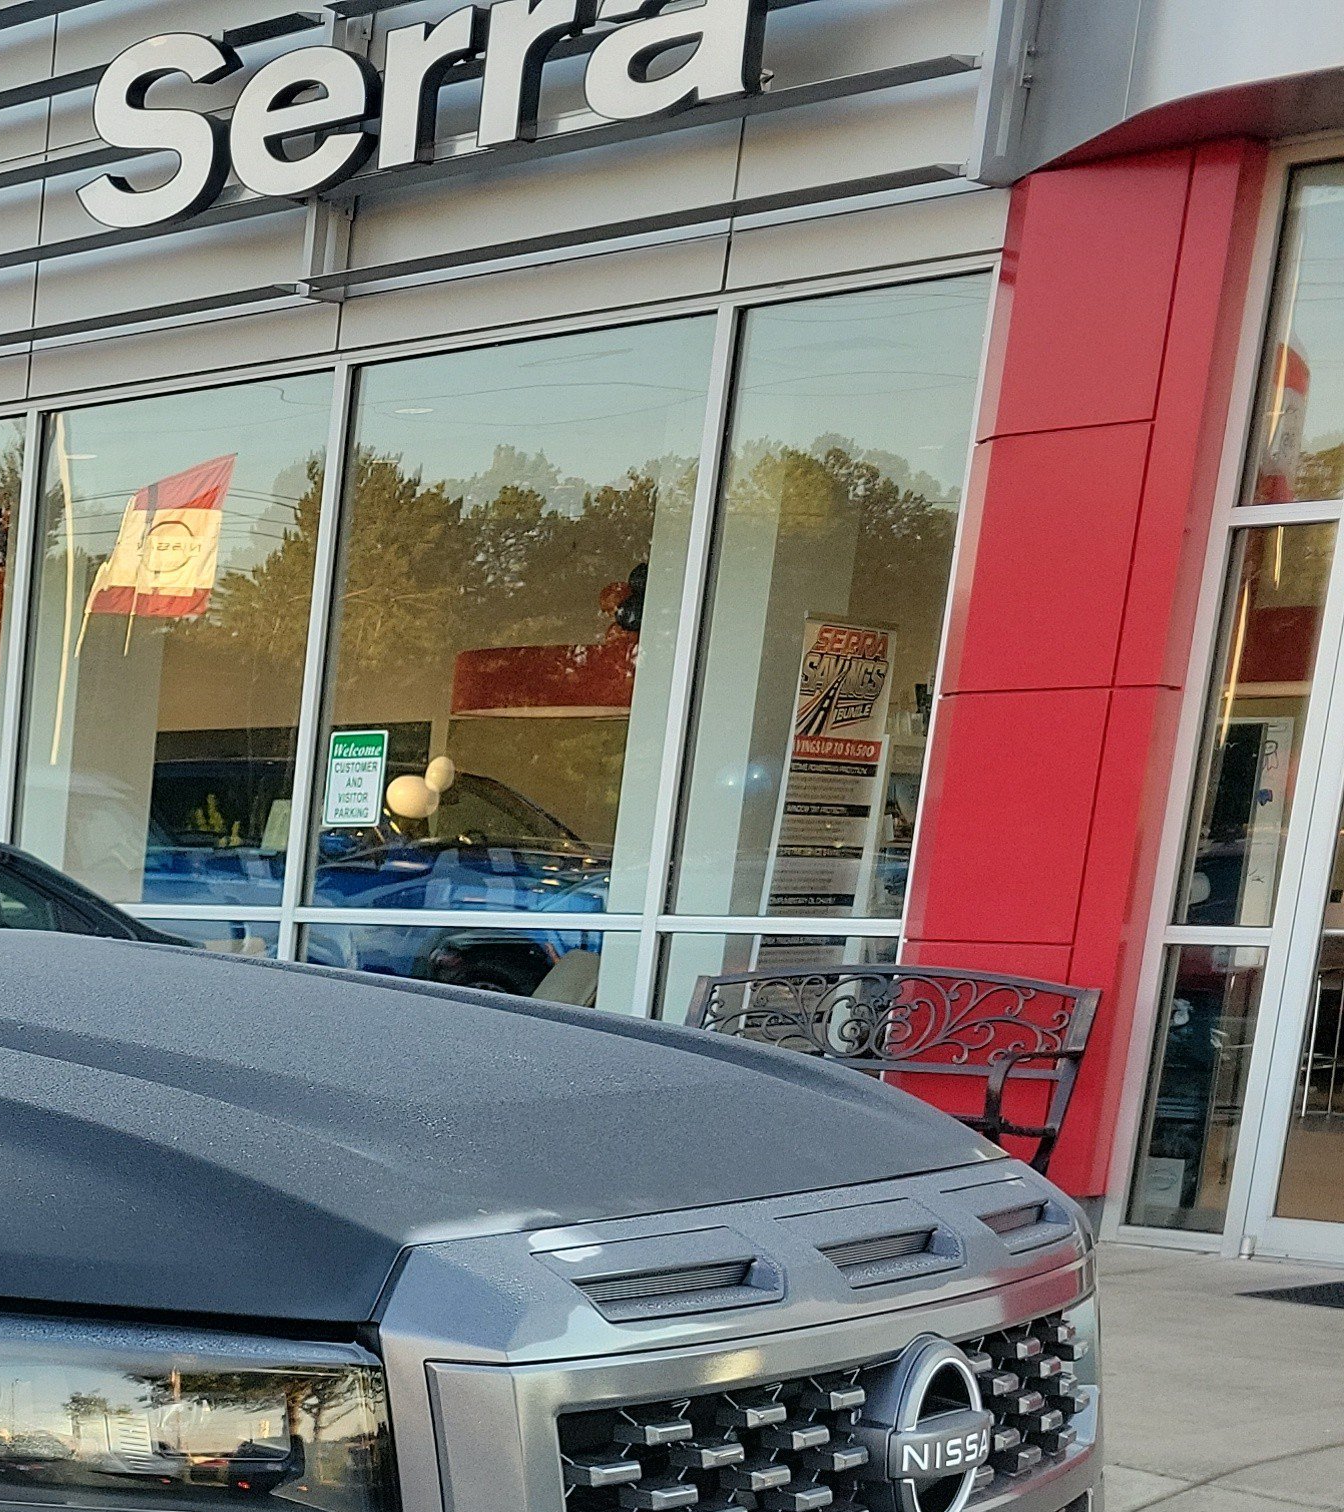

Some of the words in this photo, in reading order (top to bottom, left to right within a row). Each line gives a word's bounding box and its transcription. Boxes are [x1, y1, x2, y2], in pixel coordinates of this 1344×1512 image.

[76, 0, 748, 229] Serra
[333, 742, 382, 757] Welcome
[334, 761, 378, 773] CUSTOMER
[346, 777, 363, 788] AND
[338, 792, 369, 803] VISITOR
[334, 807, 369, 819] PARKING
[901, 1428, 988, 1472] NISSA
